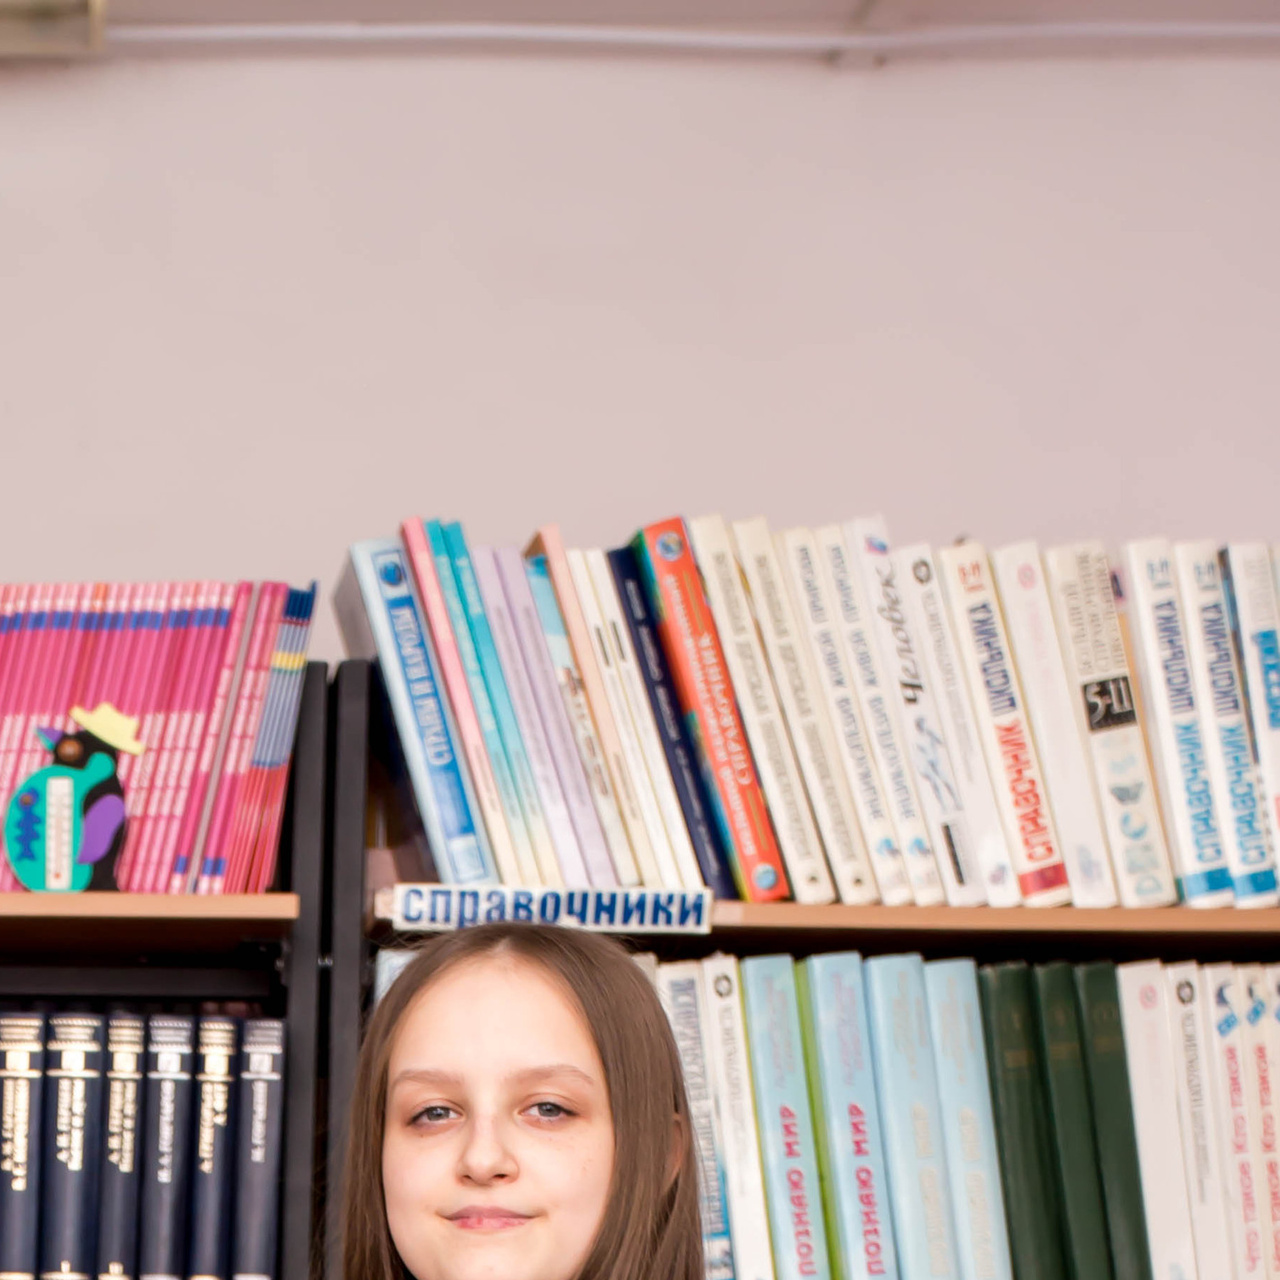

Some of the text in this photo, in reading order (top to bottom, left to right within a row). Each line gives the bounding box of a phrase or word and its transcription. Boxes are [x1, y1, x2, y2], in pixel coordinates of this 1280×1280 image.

[865, 562, 929, 709] Человек
[967, 600, 1017, 718] ШКОЛЬНИКА
[1149, 599, 1198, 716] ШКОЛЬНИКА
[1193, 603, 1243, 718] ШКОЛЬНИКА
[696, 630, 752, 788] СПРАВОЧНИК
[993, 716, 1055, 865] СПРАВОЧНИК
[1169, 720, 1225, 865] СПРАВОЧНИК
[1215, 721, 1272, 867] СПРАВОЧНИК
[402, 889, 705, 928] справочники
[778, 1104, 801, 1159] МИР
[846, 1102, 869, 1158] МИР
[1230, 1115, 1248, 1154] Кто
[785, 1168, 816, 1277] ПОЗНАЮ
[853, 1167, 886, 1276] ПОЗНАЮ
[1237, 1161, 1256, 1223] такое
[1242, 1232, 1261, 1272] Что
